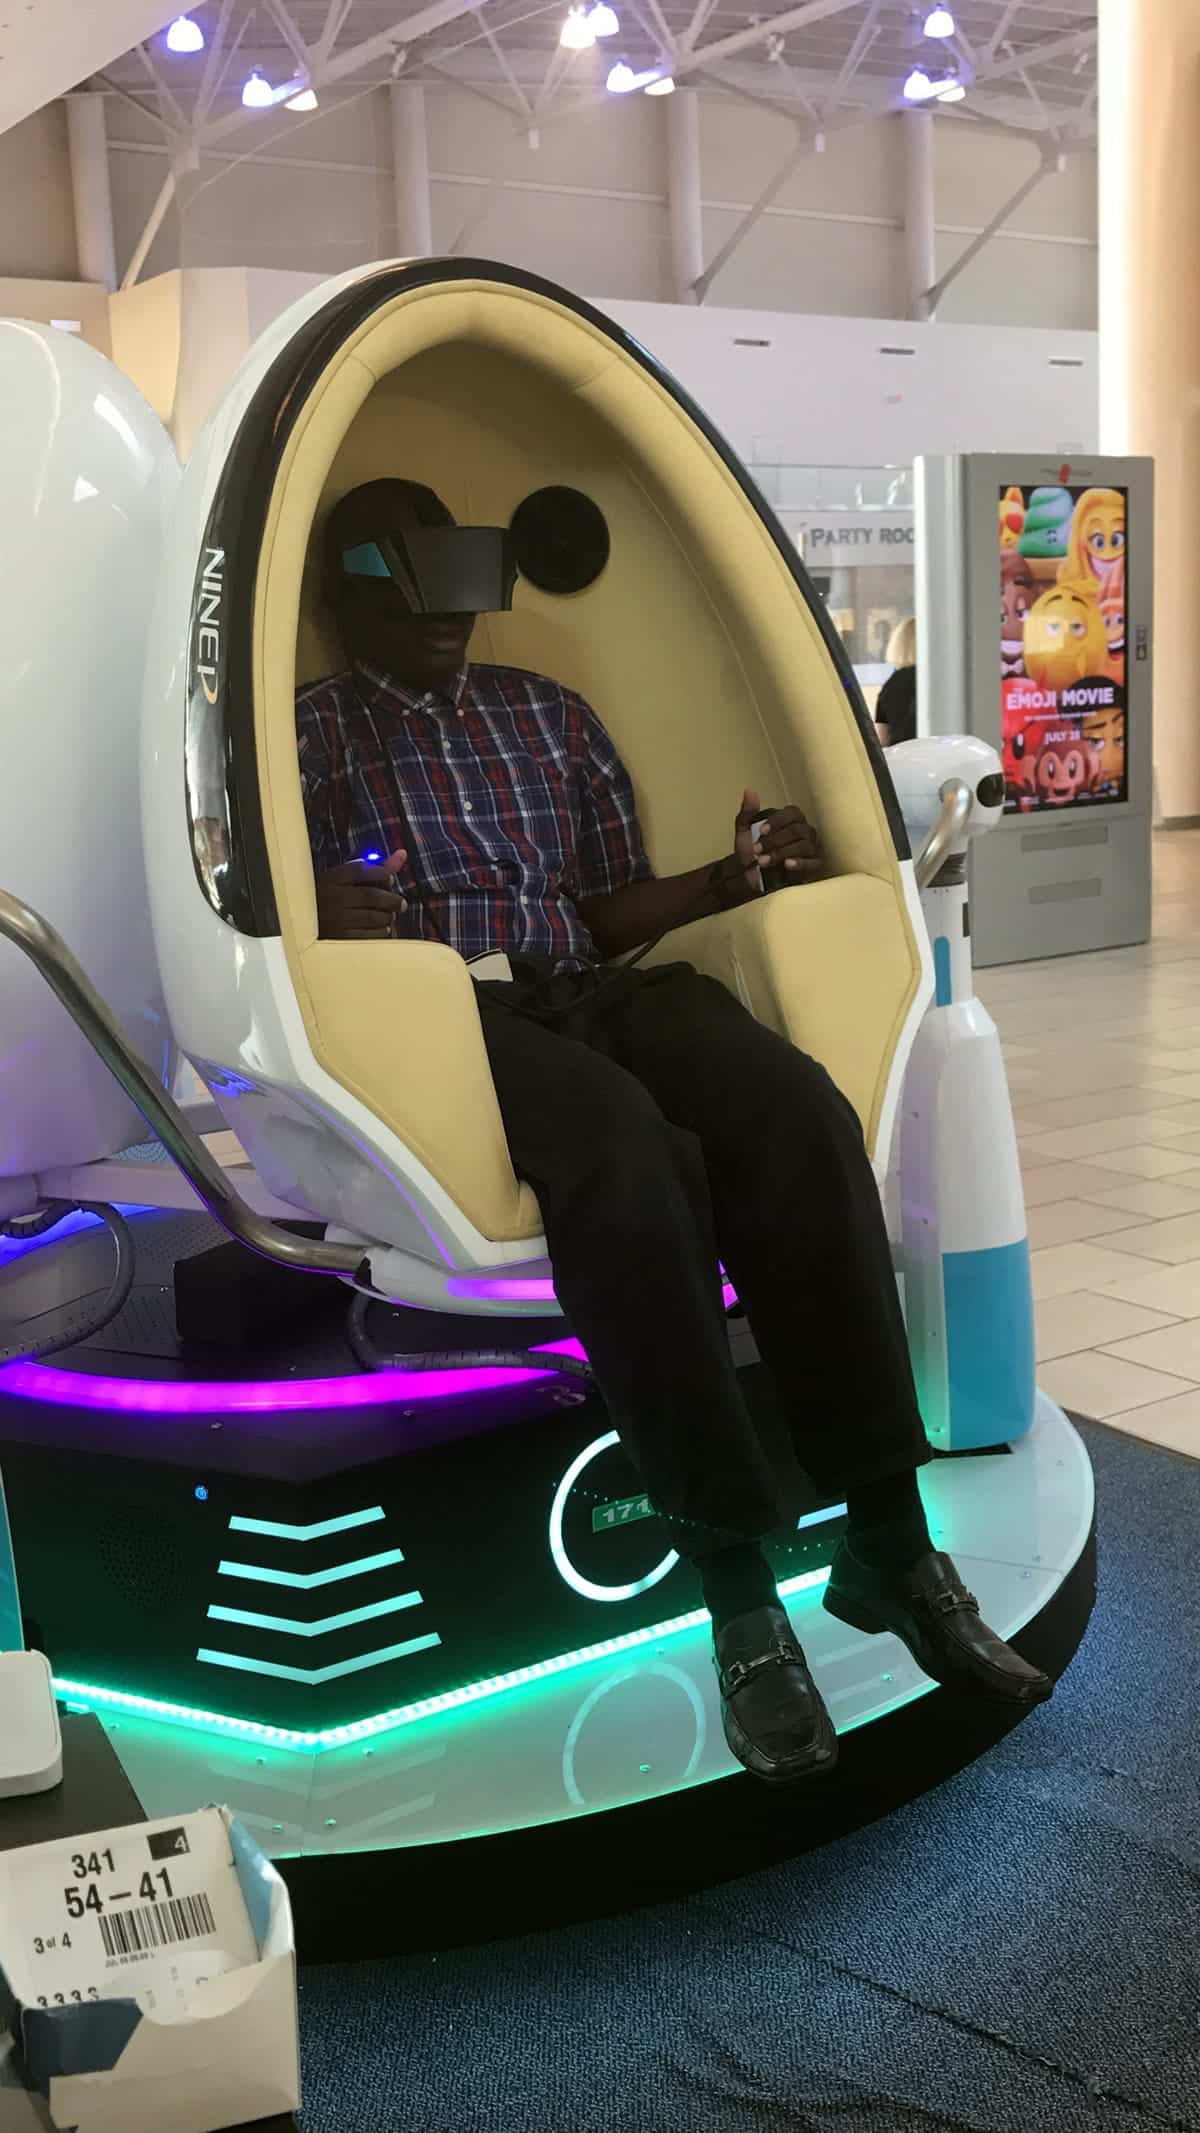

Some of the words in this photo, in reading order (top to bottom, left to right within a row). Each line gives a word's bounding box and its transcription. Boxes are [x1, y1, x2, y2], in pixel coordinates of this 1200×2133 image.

[810, 528, 872, 547] PARTY
[1006, 690, 1057, 710] EMOJI
[1062, 687, 1114, 706] MOVIE
[174, 1835, 188, 1852] 4
[71, 1848, 115, 1879] 341
[33, 1937, 45, 1954] 3
[61, 1932, 72, 1949] 4
